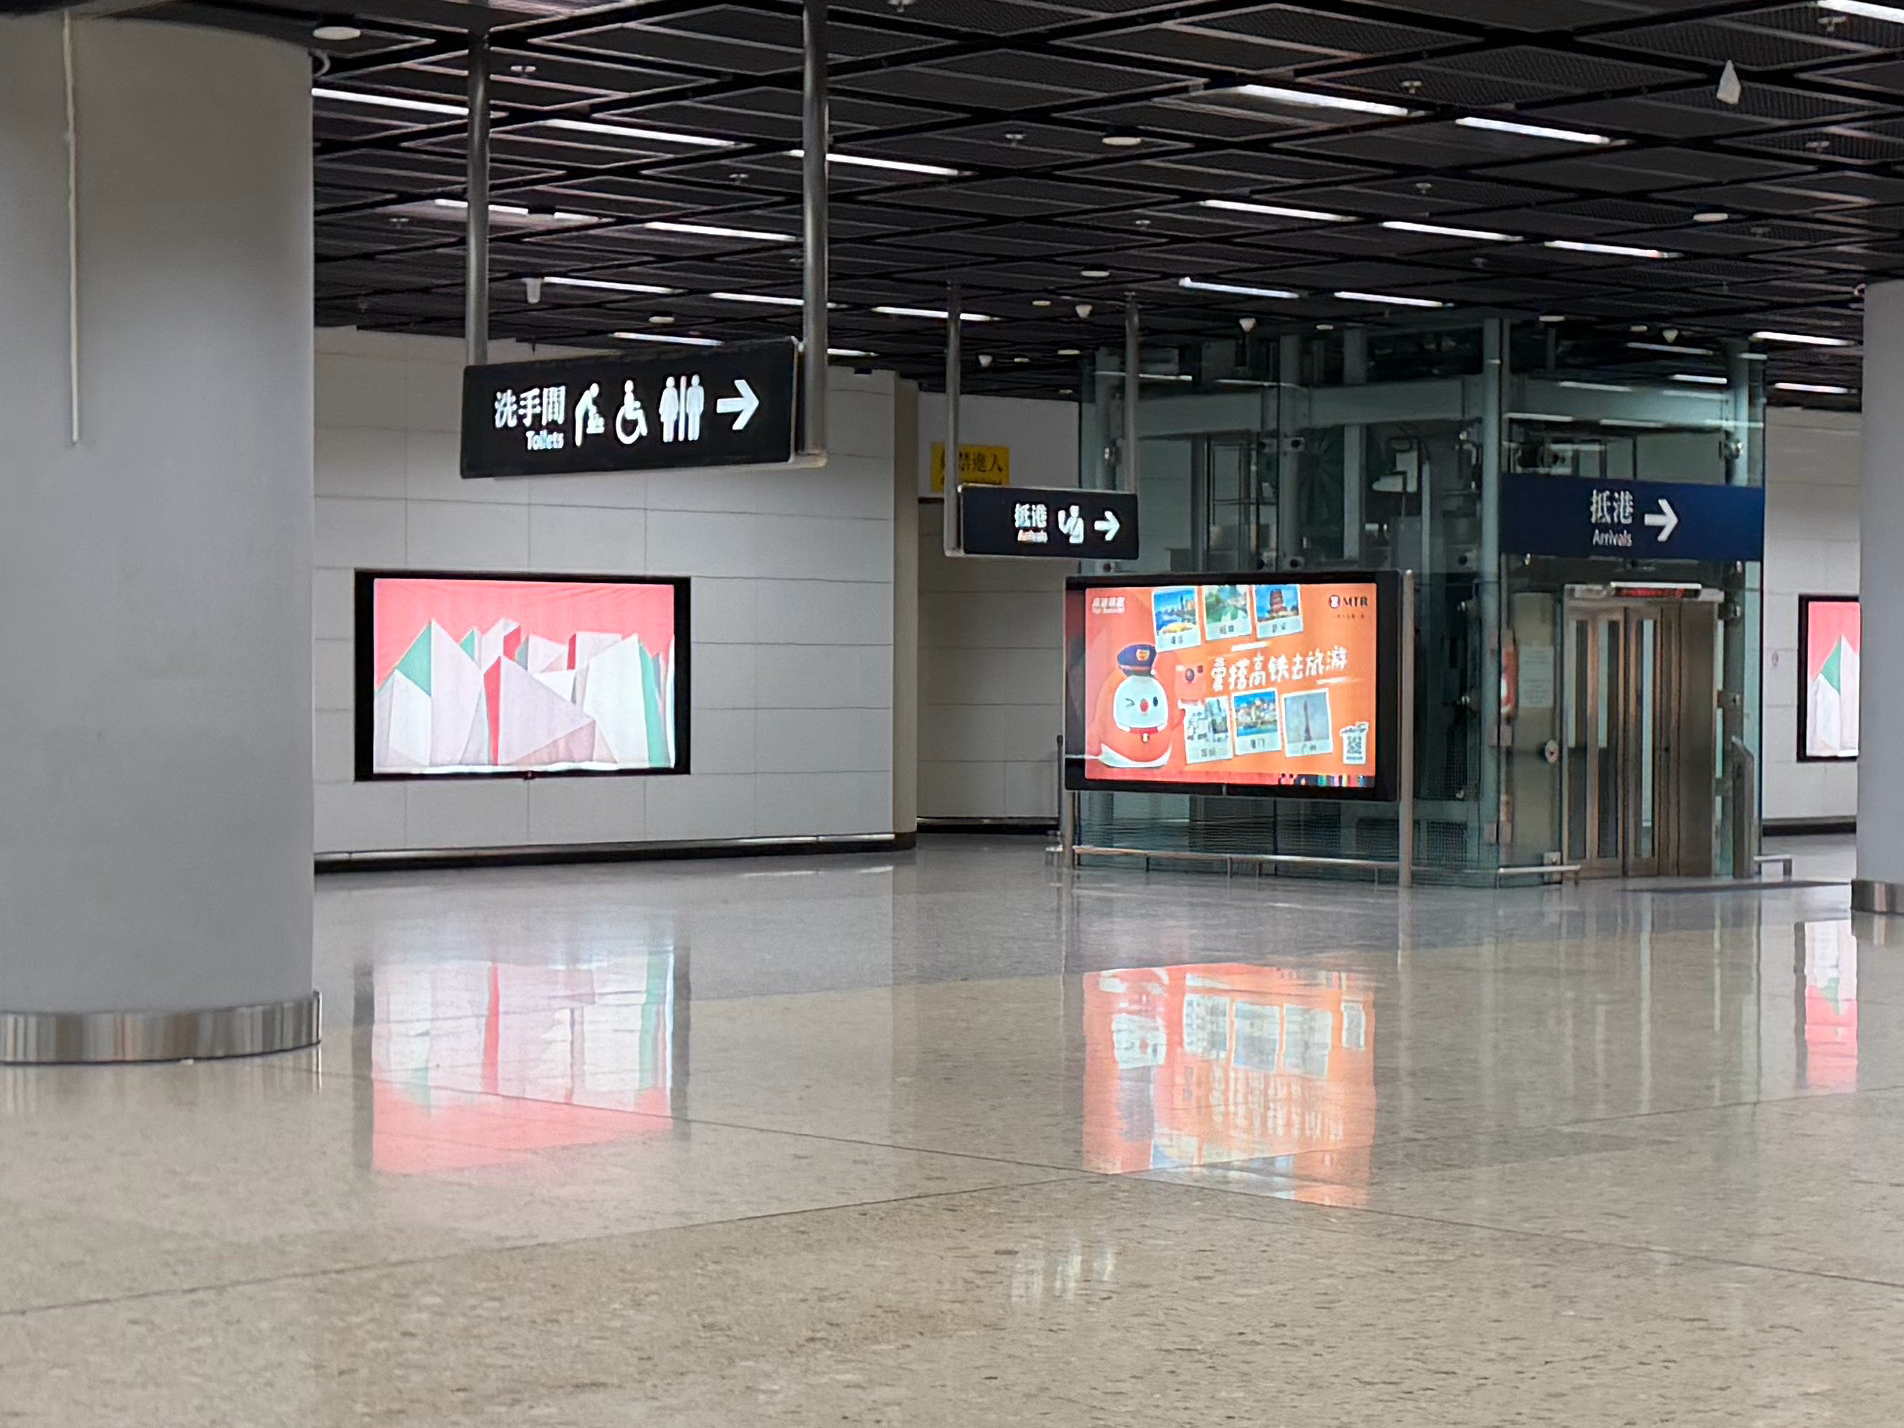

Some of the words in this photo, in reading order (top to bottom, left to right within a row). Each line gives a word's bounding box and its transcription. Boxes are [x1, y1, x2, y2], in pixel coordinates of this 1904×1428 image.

[495, 385, 566, 428] 洗手間
[525, 429, 564, 450] Toilets
[940, 450, 1003, 472] 禁進入
[1590, 489, 1634, 524] 抵港
[1592, 529, 1633, 547] Arrivals
